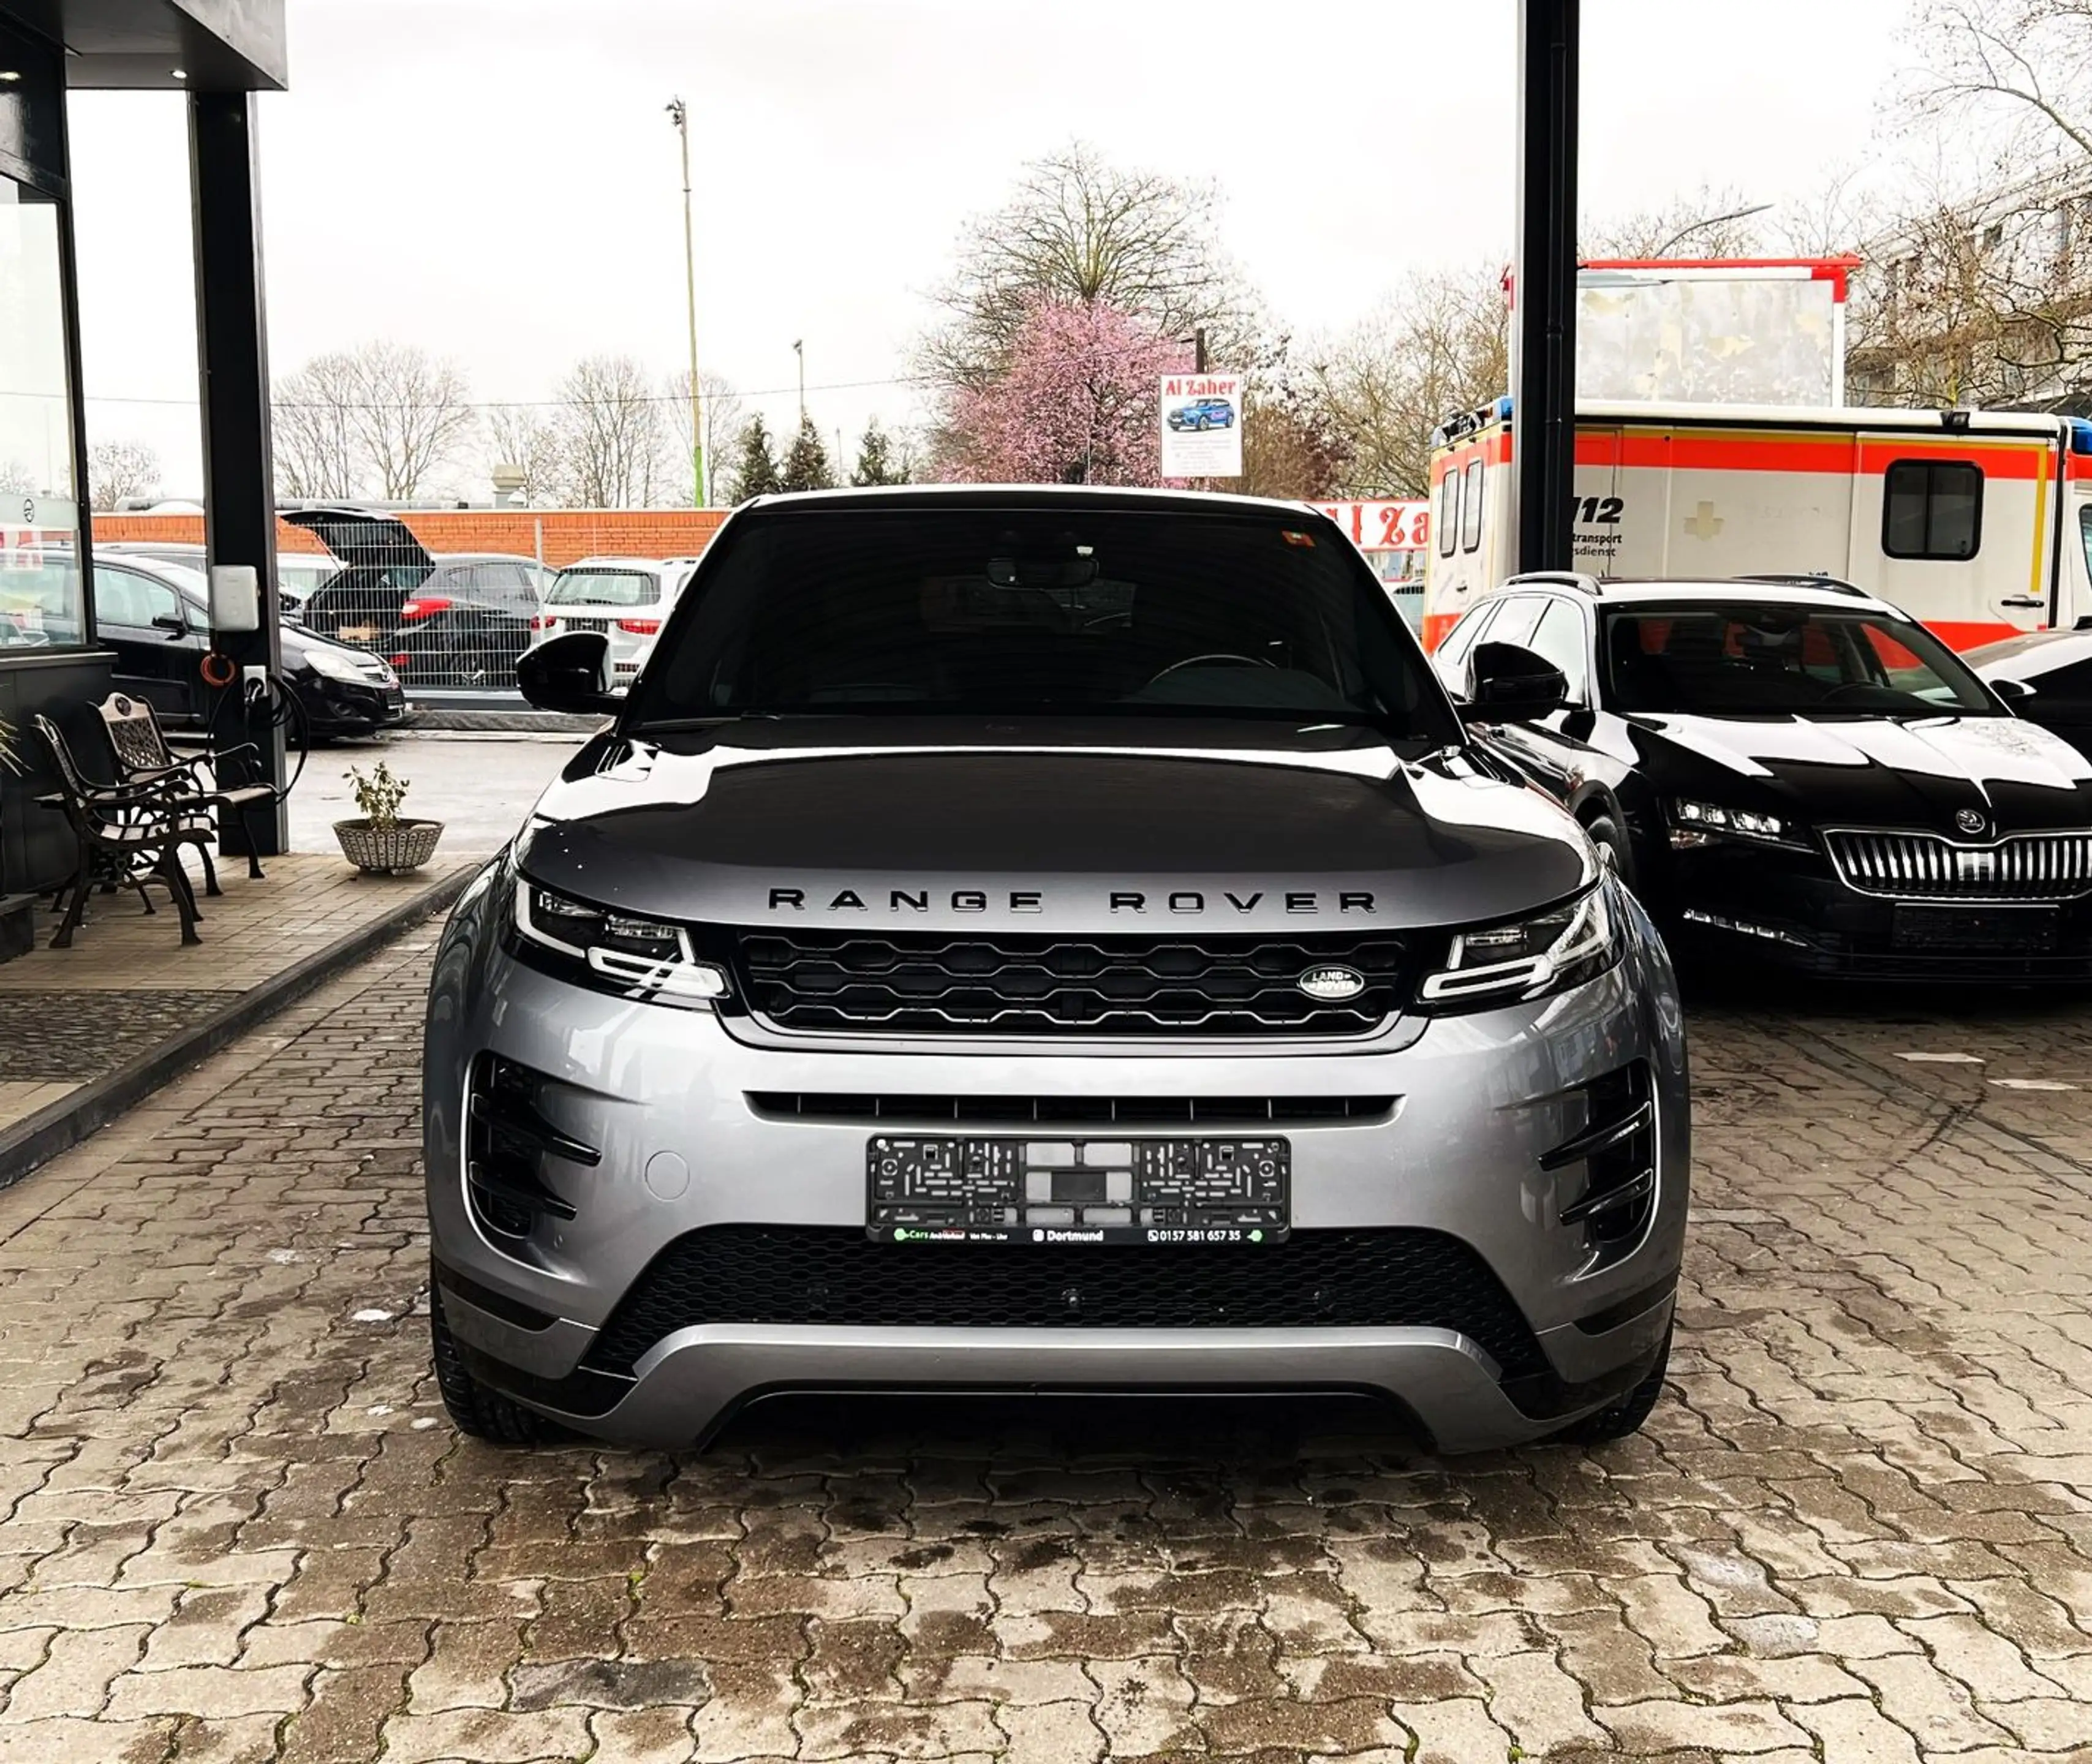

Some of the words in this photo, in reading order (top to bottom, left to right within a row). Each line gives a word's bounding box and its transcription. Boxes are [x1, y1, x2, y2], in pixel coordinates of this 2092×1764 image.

[1166, 379, 1182, 396] Al
[1186, 379, 1236, 396] Zaher
[768, 888, 1042, 913] RANGE
[1109, 892, 1377, 914] ROVER
[1312, 971, 1343, 981] LAND
[1047, 1230, 1104, 1242] Dortmund
[1160, 1230, 1185, 1241] 0157
[1187, 1230, 1205, 1241] 581
[1207, 1230, 1226, 1241] 657
[1228, 1230, 1241, 1241] 35
